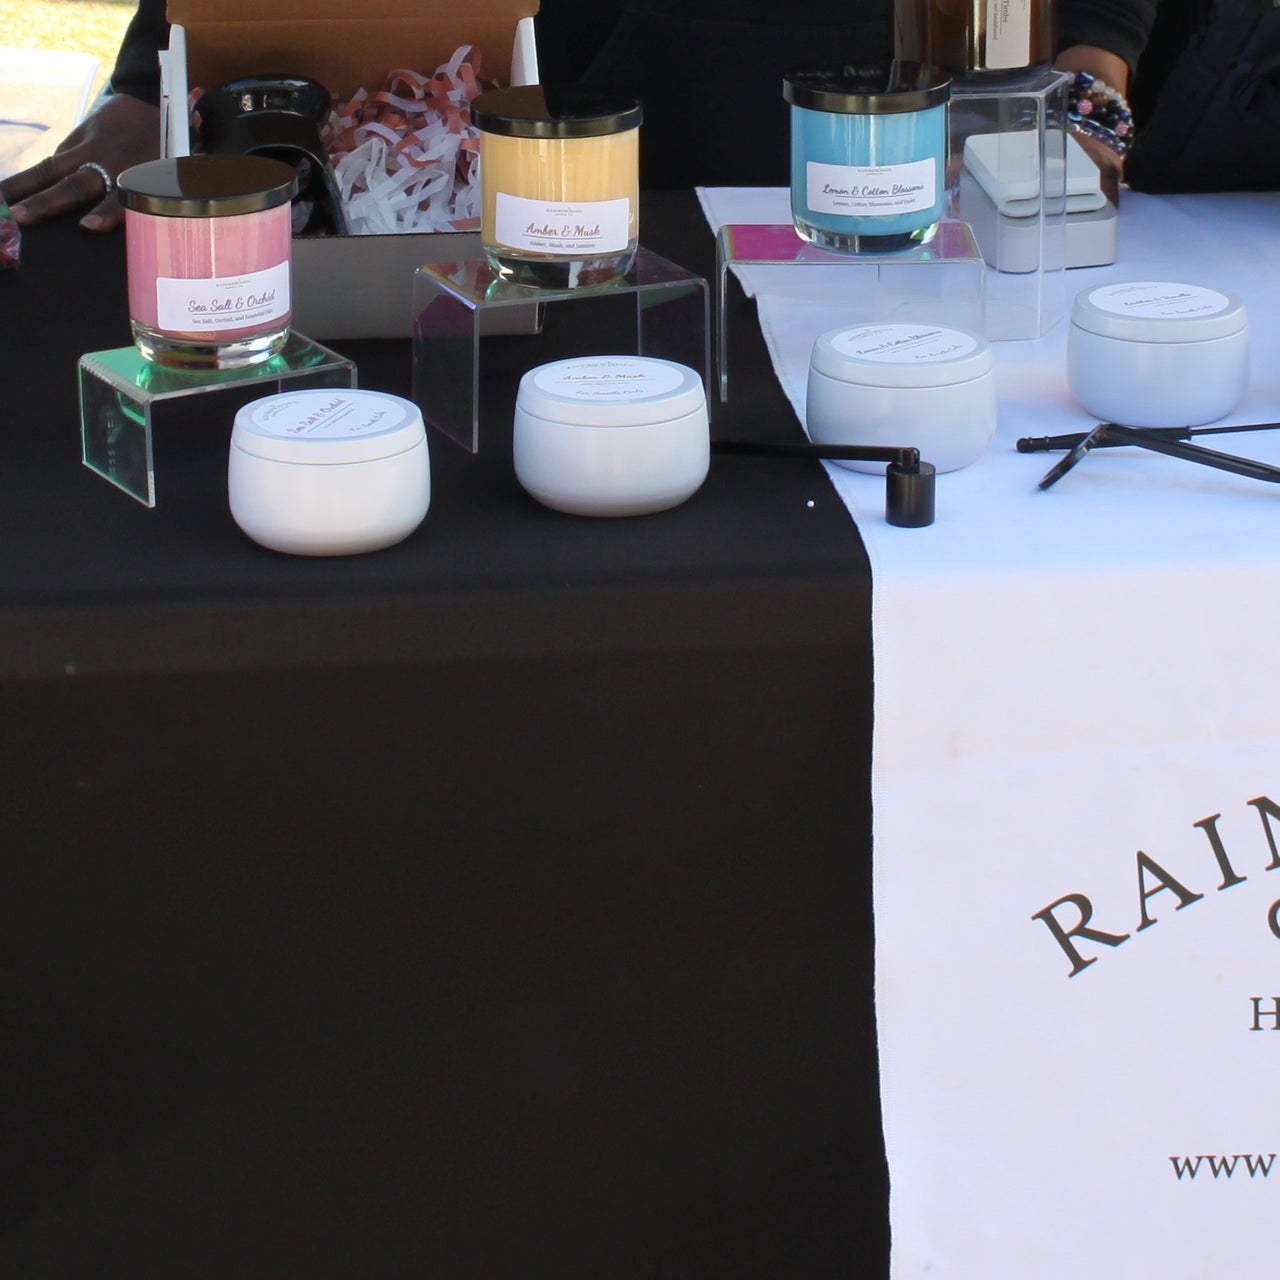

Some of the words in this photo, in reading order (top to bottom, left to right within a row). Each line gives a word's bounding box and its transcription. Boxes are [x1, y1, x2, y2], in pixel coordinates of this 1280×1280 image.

[1001, 0, 1011, 23] Timbs
[822, 183, 850, 195] Lemon
[851, 184, 860, 196] &
[861, 184, 889, 197] Cotton
[891, 183, 925, 194] Blossoms
[527, 222, 559, 237] Amber
[561, 224, 571, 237] &
[573, 224, 601, 237] Musk
[187, 300, 207, 314] Sea
[209, 296, 235, 313] Salt
[235, 295, 245, 310] &
[246, 289, 276, 307] Orchid
